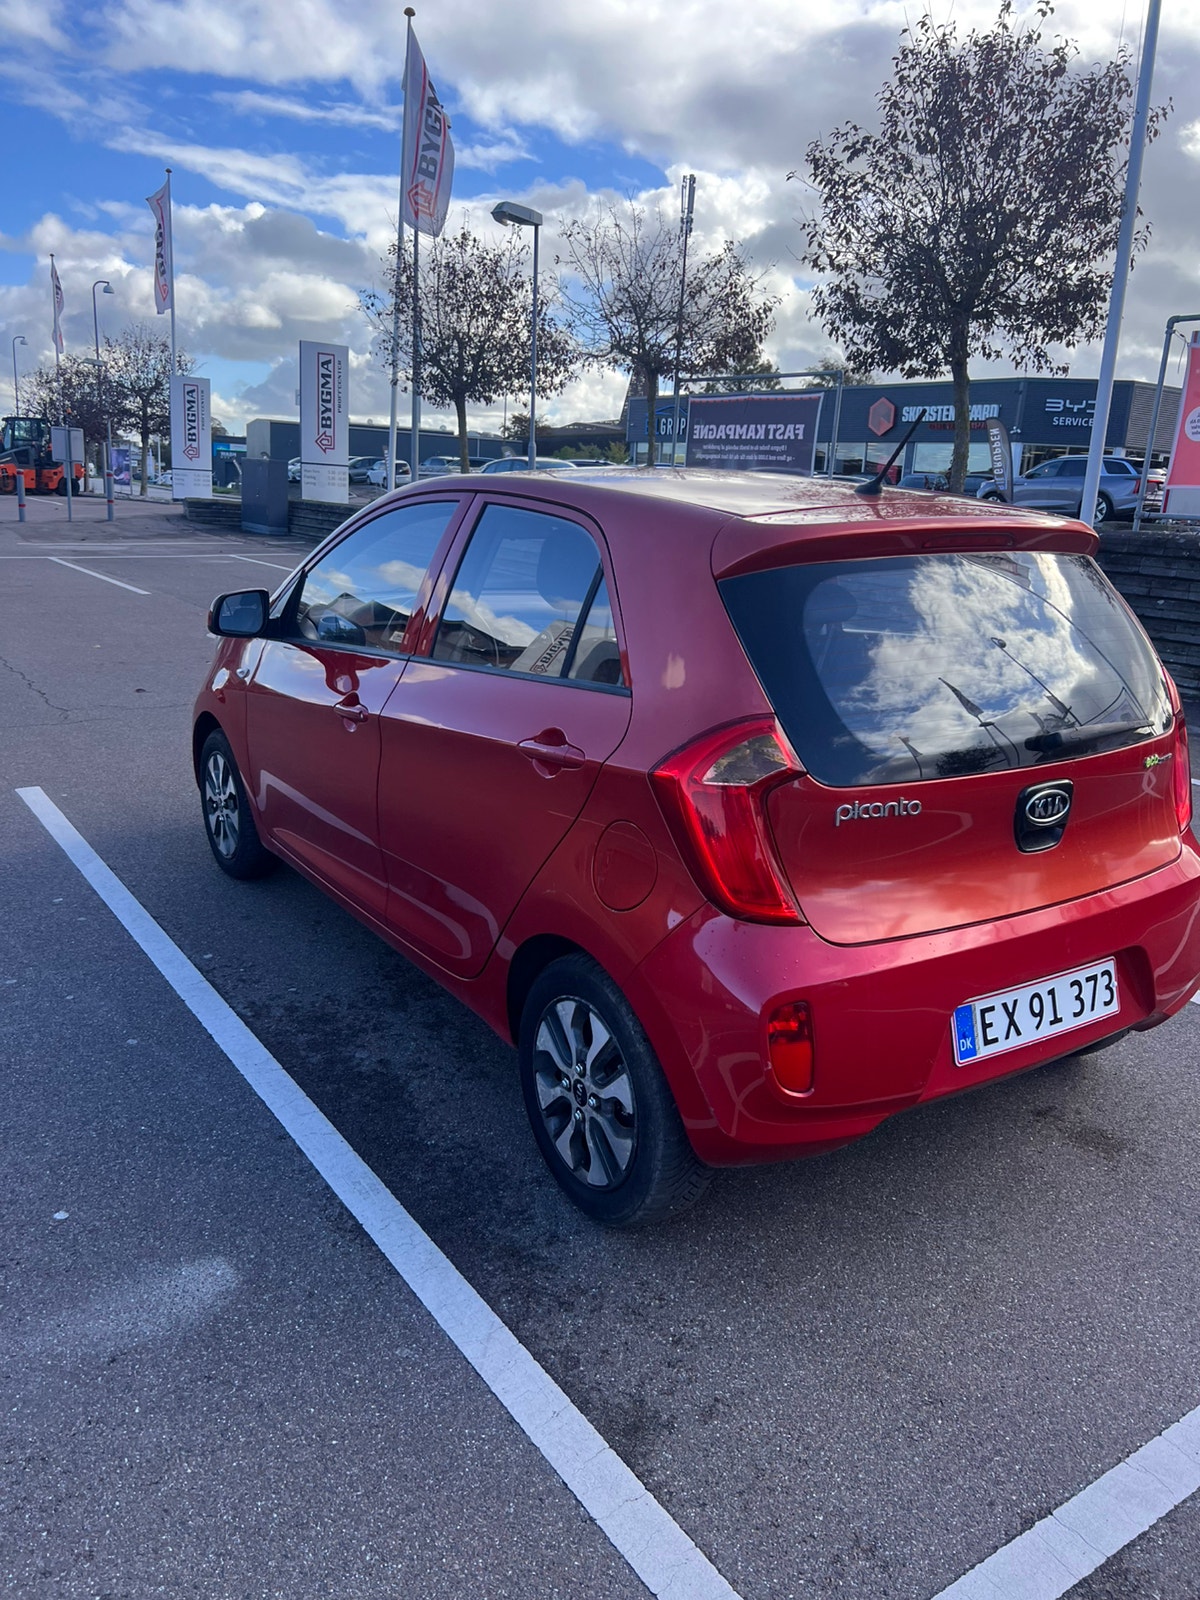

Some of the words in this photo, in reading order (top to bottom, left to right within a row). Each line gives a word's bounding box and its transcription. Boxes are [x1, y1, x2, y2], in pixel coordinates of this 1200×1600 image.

[320, 359, 332, 429] BYGMA
[186, 388, 197, 443] BYGMA
[1052, 416, 1094, 427] SERVICE
[835, 796, 922, 827] picanto
[1033, 795, 1064, 818] KIA
[979, 998, 1022, 1047] EX
[1029, 986, 1063, 1031] 91
[1069, 969, 1115, 1018] 373
[959, 1037, 973, 1051] DK
